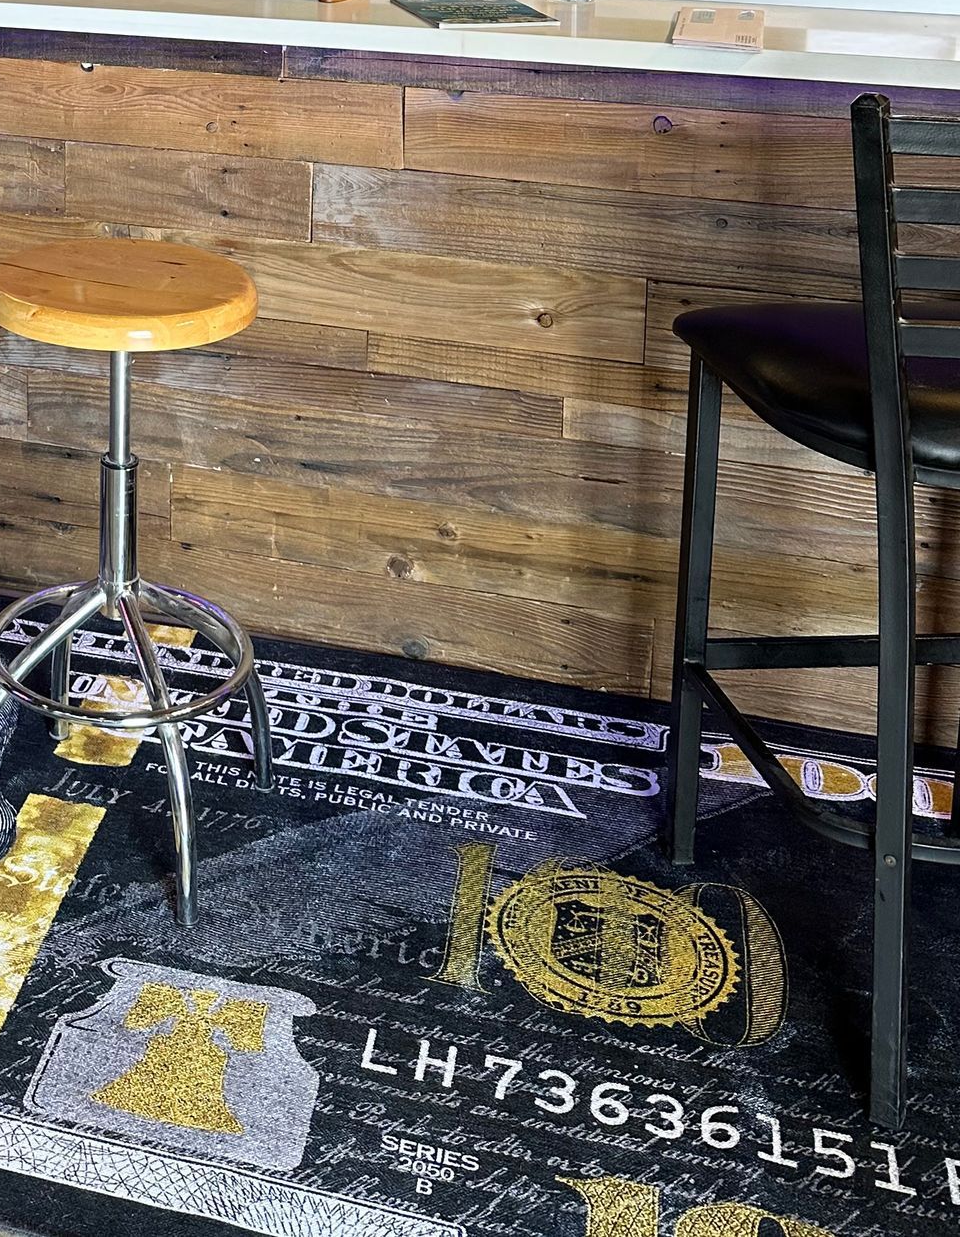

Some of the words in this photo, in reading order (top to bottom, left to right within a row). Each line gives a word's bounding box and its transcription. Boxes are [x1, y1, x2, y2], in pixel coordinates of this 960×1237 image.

[191, 771, 228, 786] ALL
[235, 777, 307, 801] DTS,
[314, 792, 393, 814] PUBLIC
[397, 803, 443, 824] AND
[449, 817, 539, 843] PRIVATE
[194, 762, 240, 777] THIS
[247, 770, 301, 788] NTE
[308, 780, 326, 791] IS
[338, 784, 399, 805] LEGAL
[405, 797, 489, 821] TENDER
[484, 1054, 918, 1196] 73636151
[380, 1134, 480, 1172] SERIES
[397, 1156, 456, 1182] 2050
[415, 1177, 434, 1196] B
